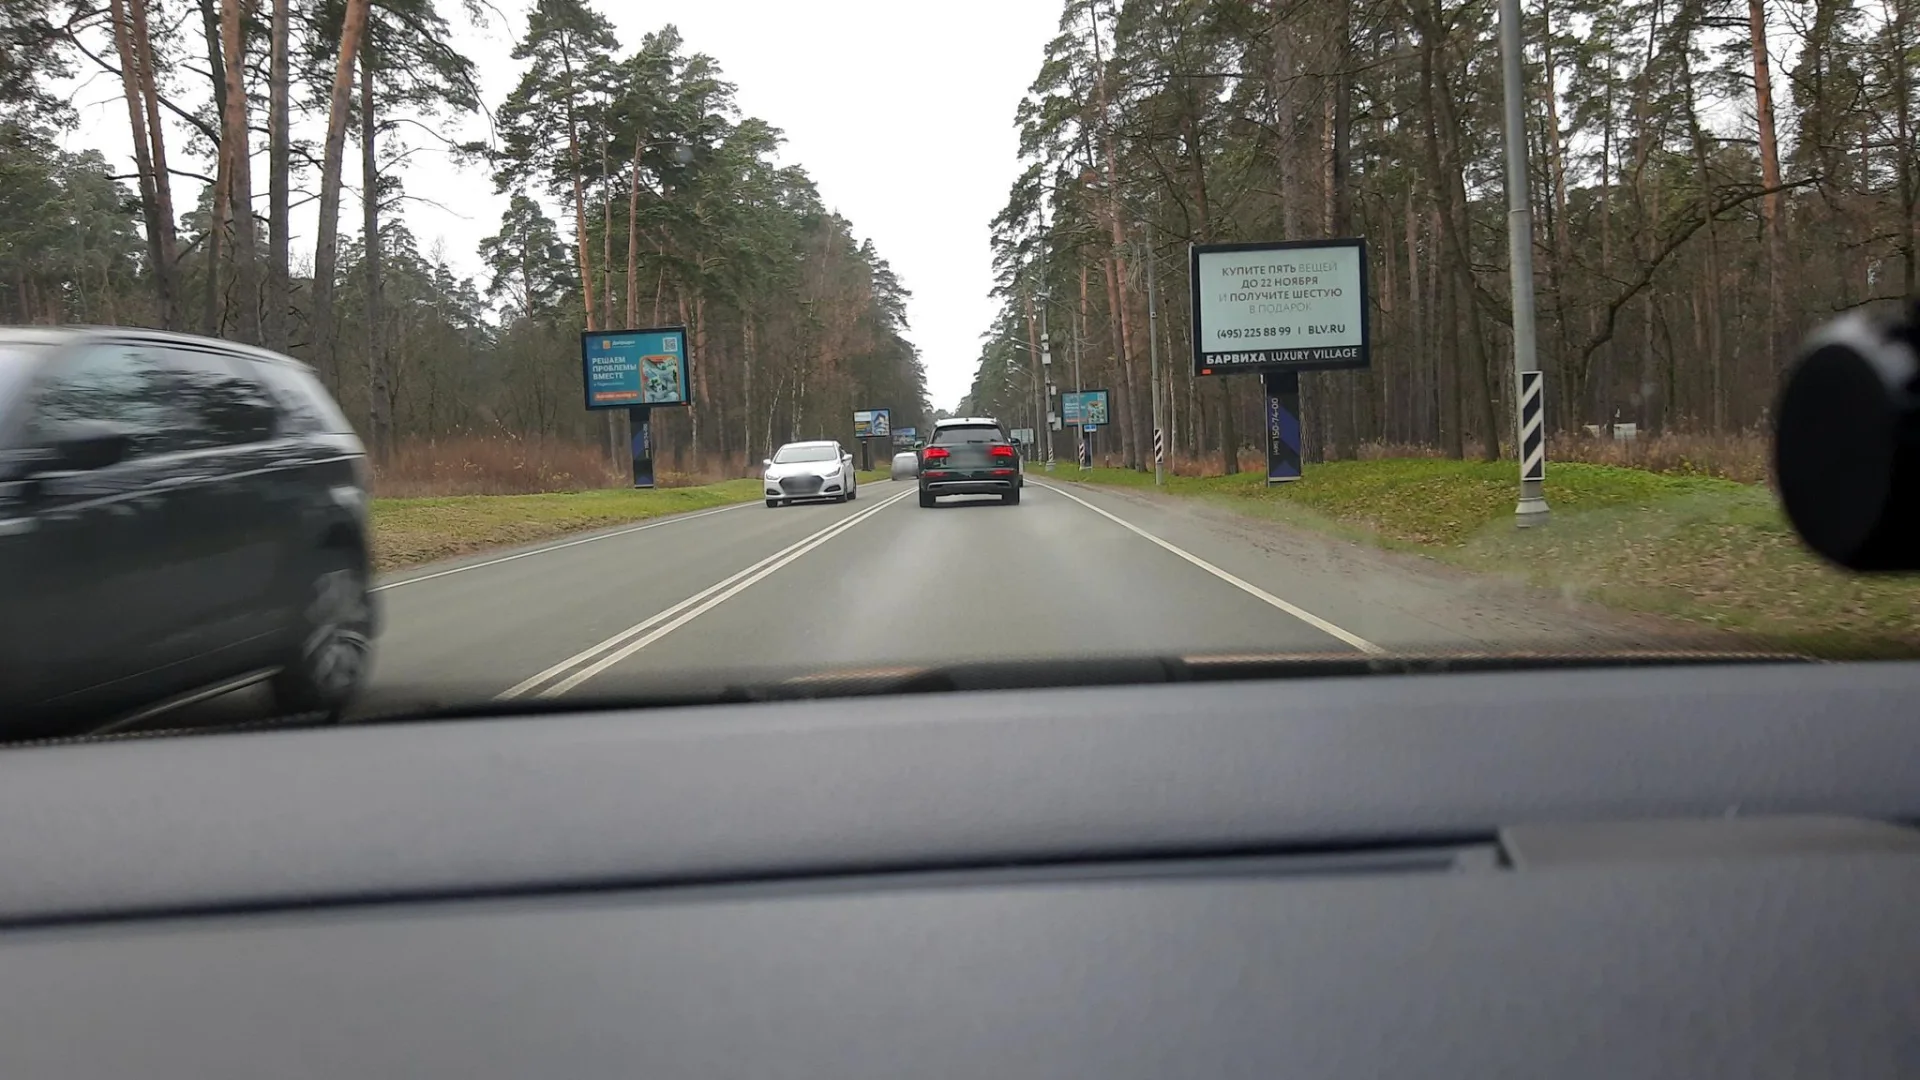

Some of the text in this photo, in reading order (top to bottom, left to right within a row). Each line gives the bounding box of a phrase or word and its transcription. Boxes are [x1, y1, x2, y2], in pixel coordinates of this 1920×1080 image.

[1222, 262, 1338, 277] КУПИТЕ ПЯТЬ ВЕЩЕЙ
[1241, 276, 1318, 289] ДО 22 НОЯБРЯ
[1218, 288, 1342, 302] И ПОЛУЧИТЕ ШЕСТУЮ
[1249, 302, 1312, 314] В ПОДАРОК
[1217, 328, 1242, 339] (495)
[1244, 328, 1261, 338] 225
[1263, 327, 1276, 336] 88
[1279, 326, 1291, 336] 99
[1308, 324, 1345, 335] BLV.RU
[591, 356, 626, 365] РЕШАЕМ
[1206, 348, 1357, 365] БАРВИХА LUXURY VILLAGE
[592, 364, 637, 372] ПРОБЛЕМЫ
[592, 372, 624, 380] ВМЕСТЕ
[1271, 397, 1280, 440] 150-74-00
